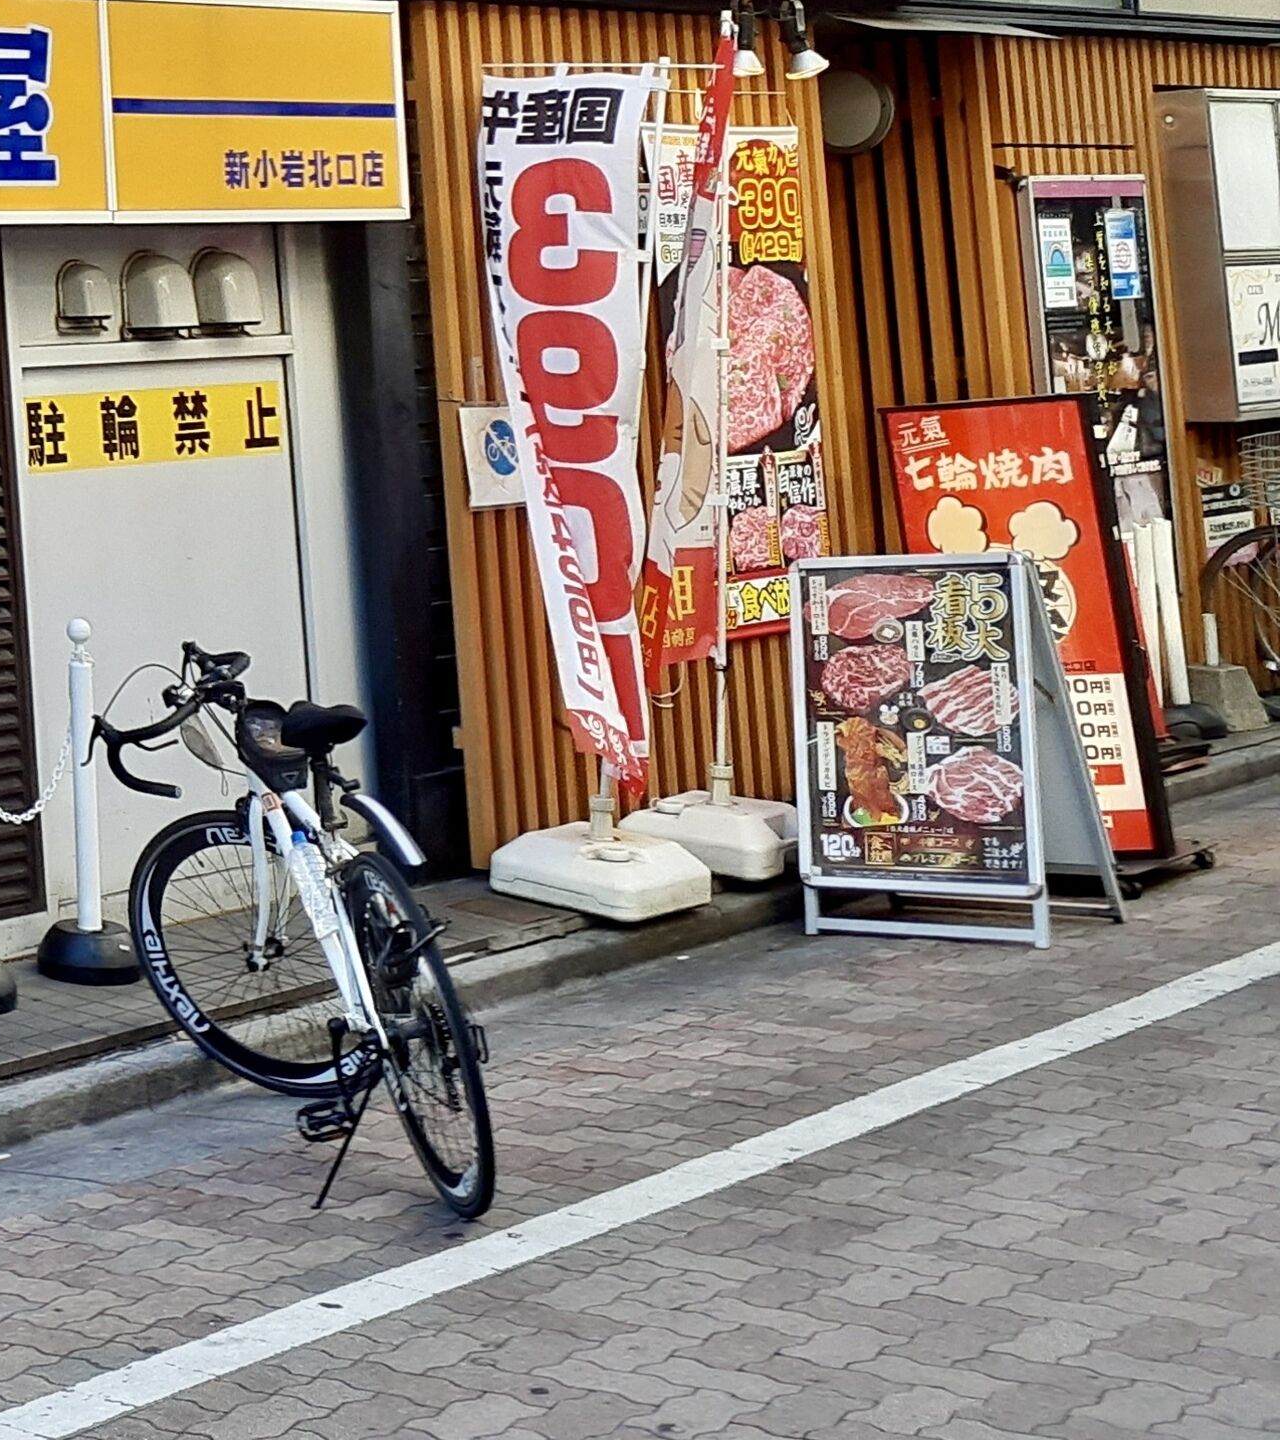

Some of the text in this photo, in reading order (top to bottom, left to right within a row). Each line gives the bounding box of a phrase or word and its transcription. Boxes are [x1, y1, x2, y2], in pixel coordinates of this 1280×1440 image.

[223, 148, 386, 191] 新小岩北口店
[25, 386, 280, 467] 駐輪禁止
[897, 415, 947, 448] 元氣
[903, 445, 1075, 493] 七輪焼肉
